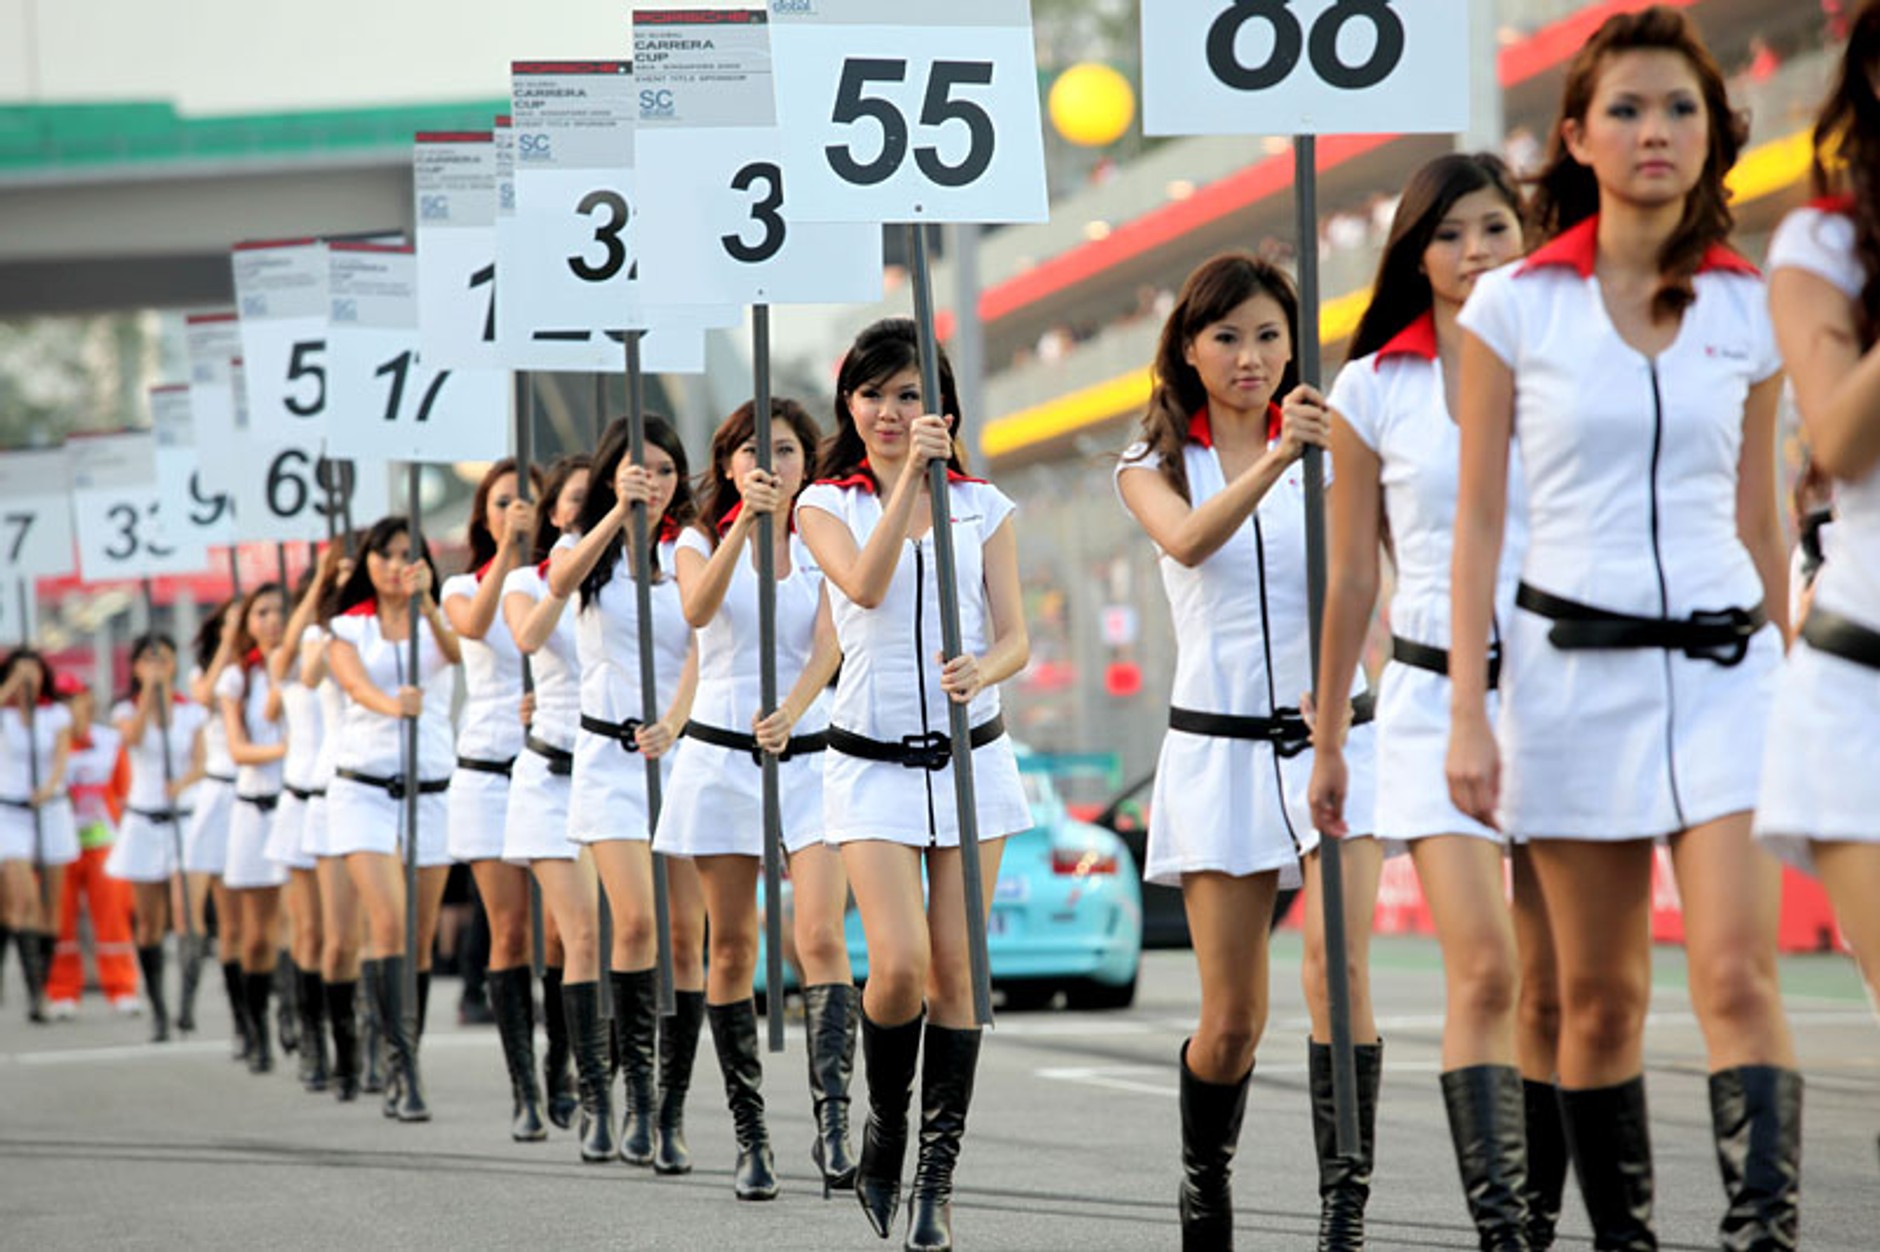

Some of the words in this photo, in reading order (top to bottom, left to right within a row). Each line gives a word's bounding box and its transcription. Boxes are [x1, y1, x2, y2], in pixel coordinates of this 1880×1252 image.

[634, 40, 714, 50] CARRERA
[634, 53, 669, 62] CUP
[1206, 0, 1405, 91] 88
[639, 89, 673, 109] SC
[825, 57, 995, 187] 55
[519, 134, 550, 152] SC
[567, 189, 638, 282] 3
[721, 161, 786, 263] 3
